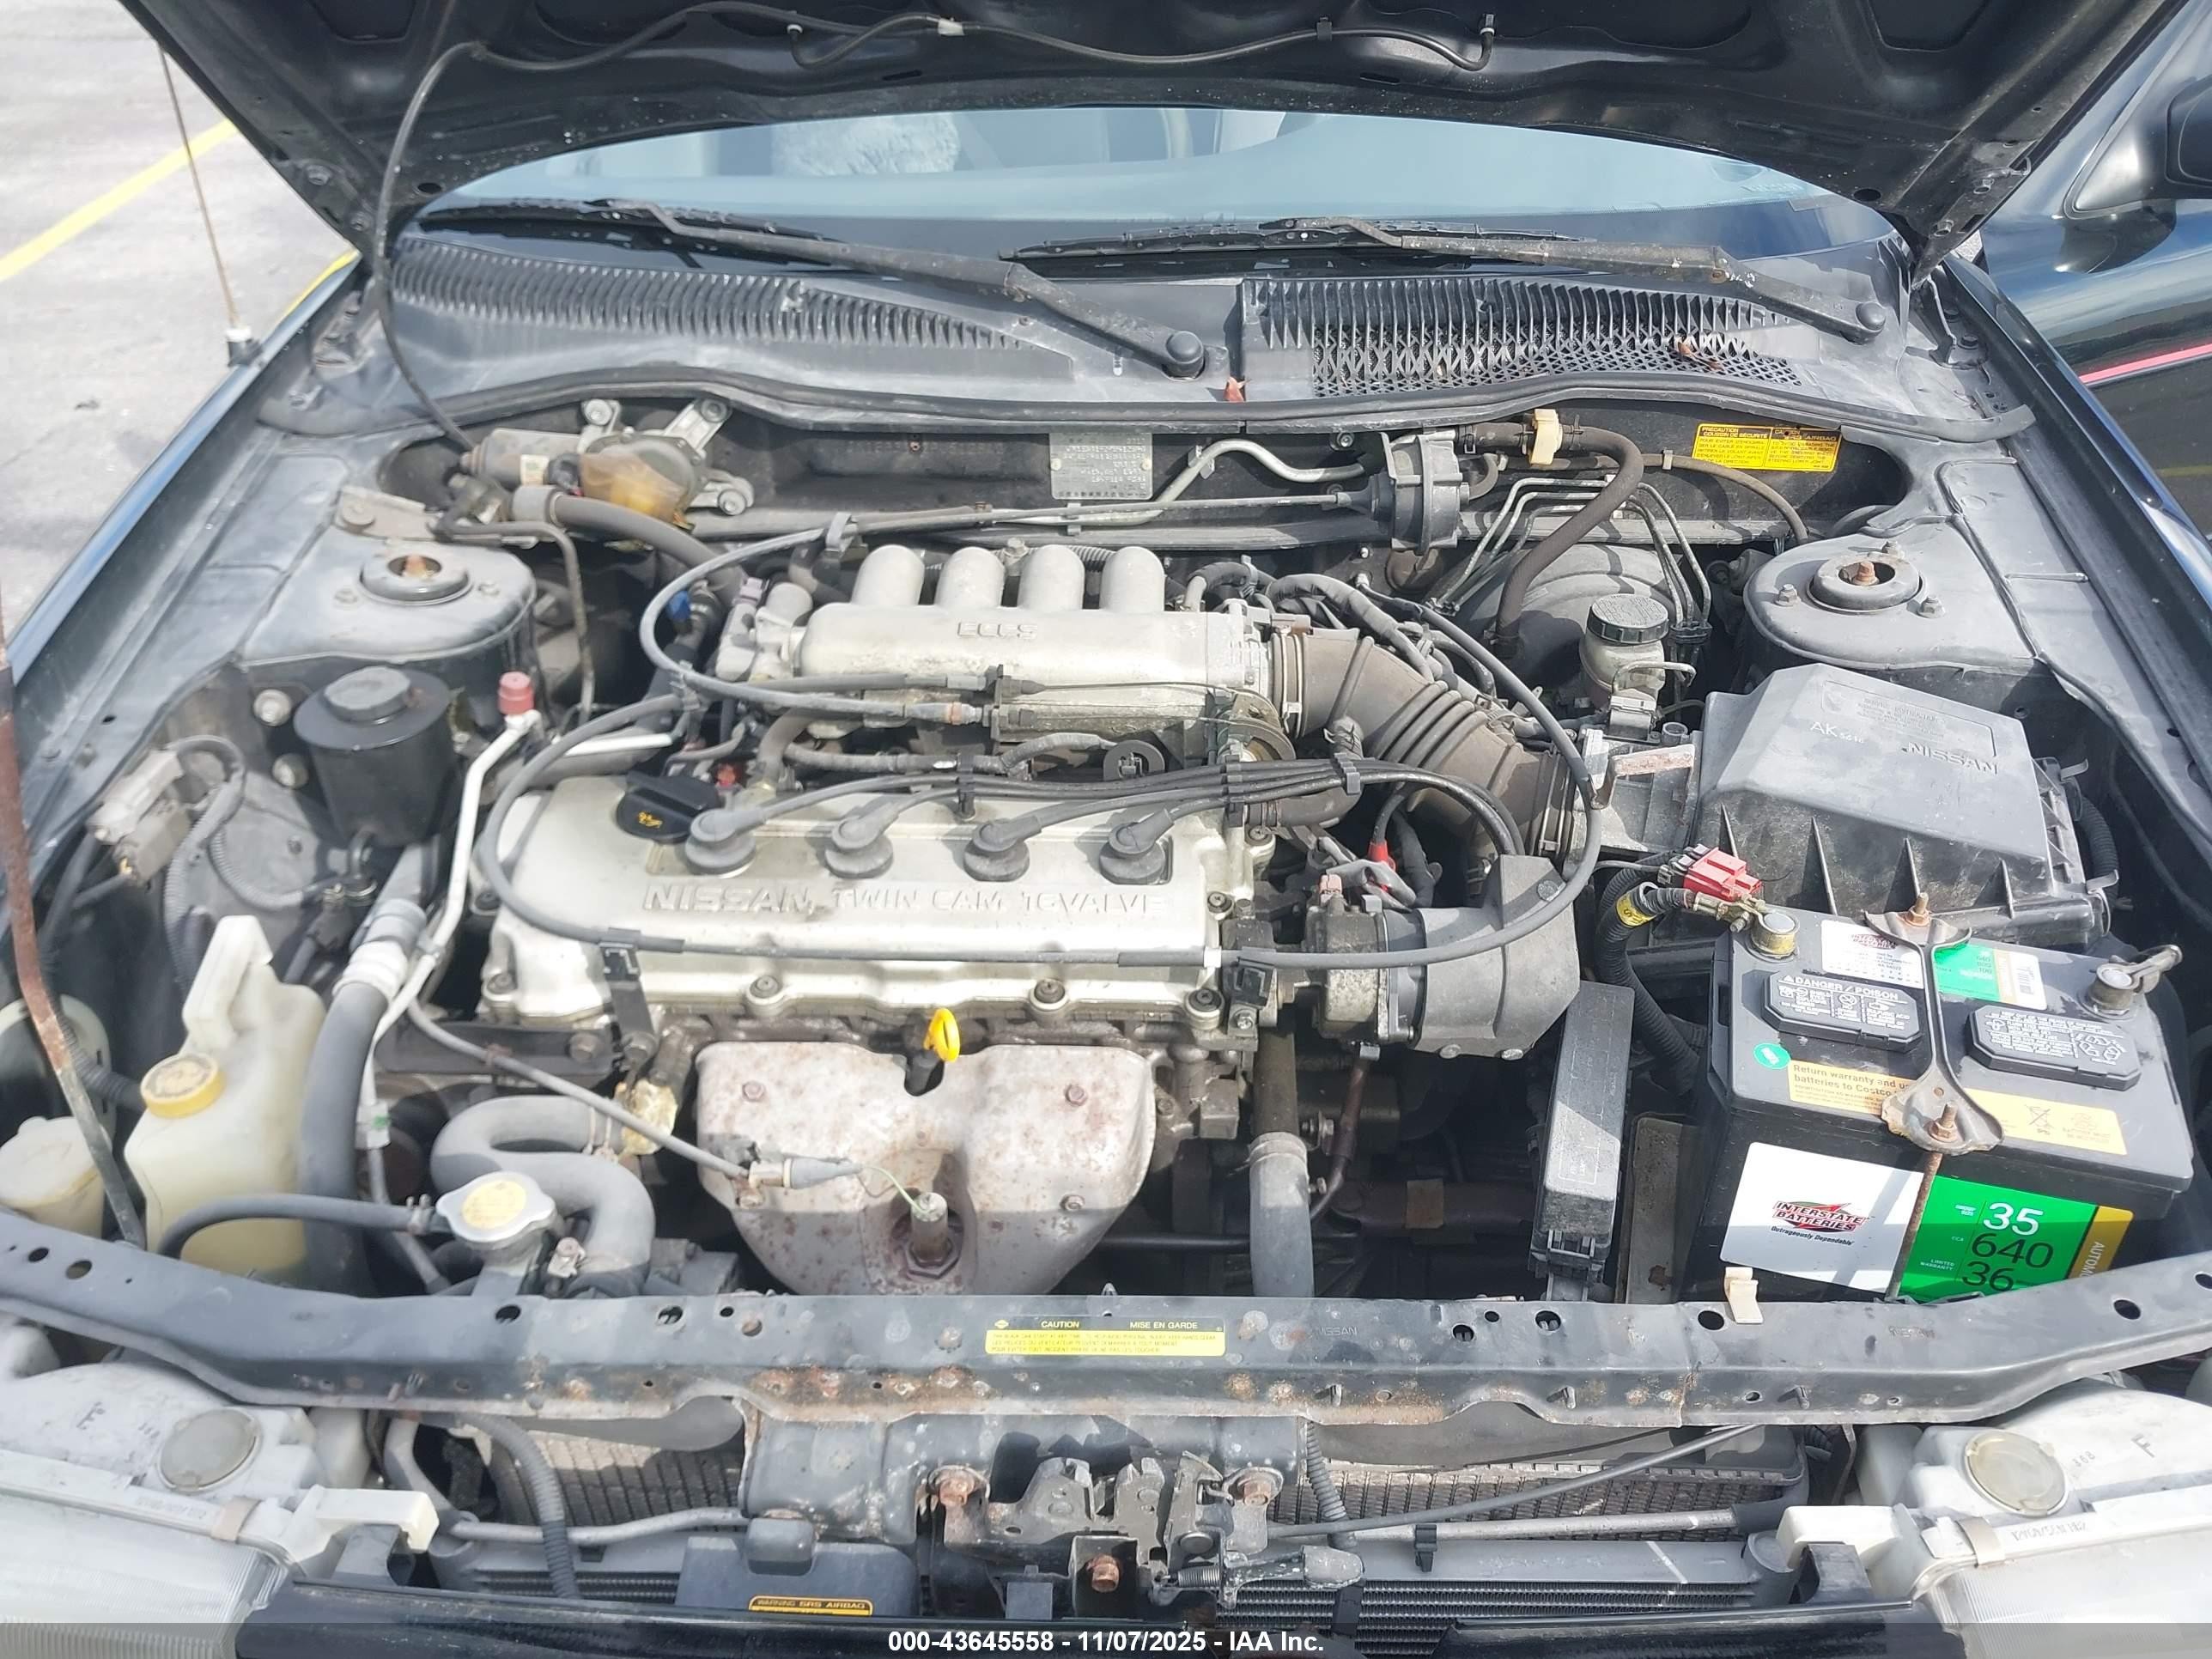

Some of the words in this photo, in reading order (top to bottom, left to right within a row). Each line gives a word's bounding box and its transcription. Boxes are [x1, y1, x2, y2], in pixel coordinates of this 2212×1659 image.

[1905, 741, 1999, 775] NISSAN
[643, 884, 813, 915] NISSAN
[831, 887, 918, 910] TWIN
[932, 889, 1002, 912] CAM
[1795, 976, 1843, 992] DANGER
[1854, 987, 1899, 1001] POISON
[1793, 1064, 1827, 1077] Return
[1830, 1071, 1875, 1086] warranty
[1876, 1078, 1896, 1088] and
[1794, 1073, 1839, 1089] batteries
[1842, 1082, 1853, 1091] to
[1856, 1084, 1892, 1097] Costco
[1775, 1210, 1856, 1231] BATTERIES
[1776, 1202, 1864, 1224] INTERSTATE
[1983, 1202, 2045, 1236] 35
[1770, 1225, 1814, 1239] Outrageously
[1814, 1234, 1853, 1246] Dependable
[1971, 1232, 2055, 1269] 640
[1961, 1260, 2015, 1292] 36
[825, 1601, 866, 1609] AIRBAG
